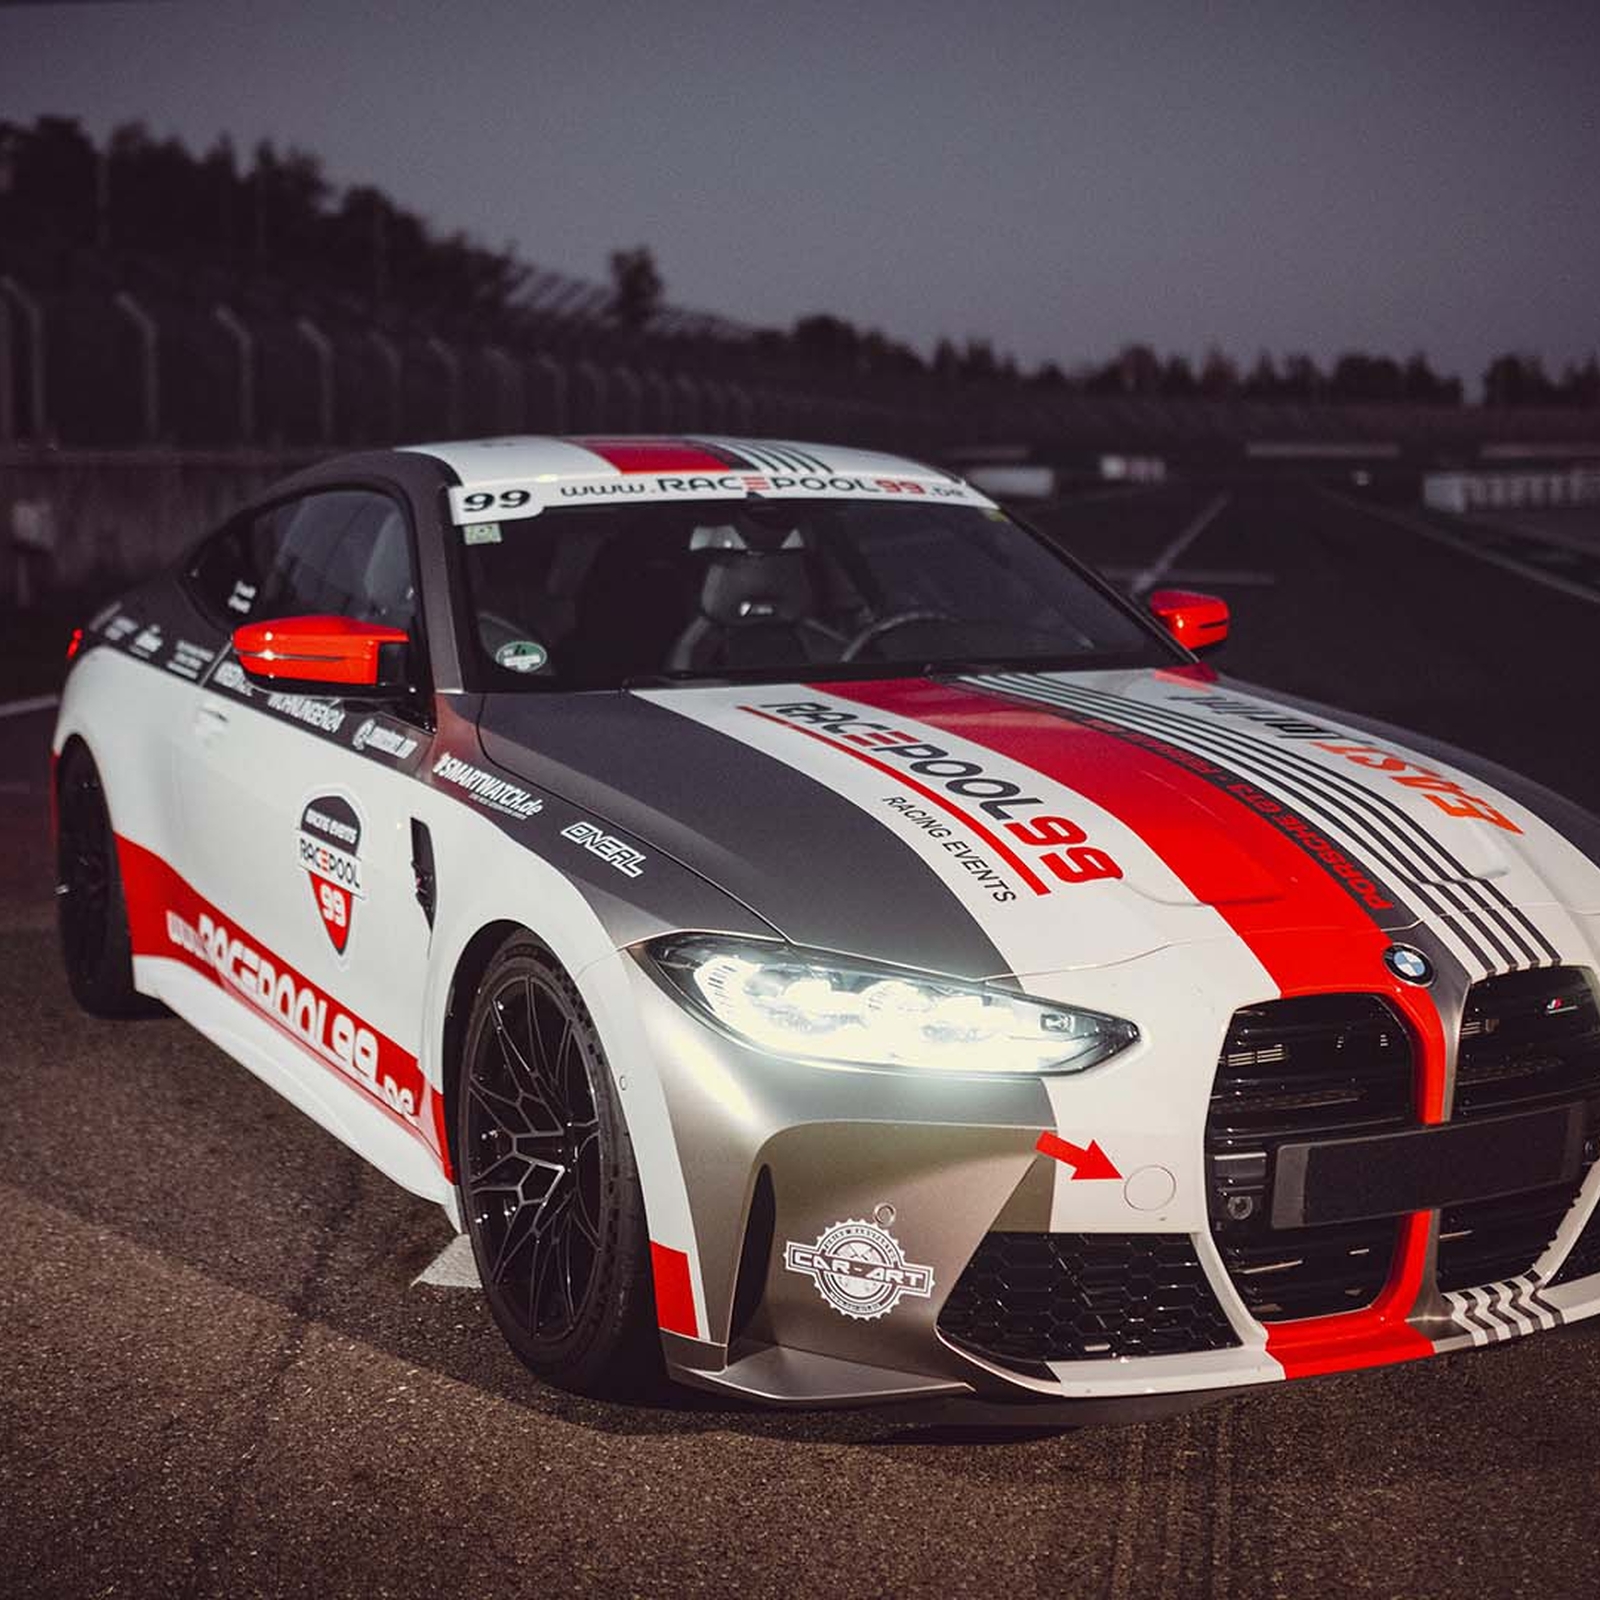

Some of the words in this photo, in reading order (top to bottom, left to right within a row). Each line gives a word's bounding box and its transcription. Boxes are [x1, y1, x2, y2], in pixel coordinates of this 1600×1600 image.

[463, 489, 531, 512] 99
[759, 702, 1124, 884] RACEPOOL99
[300, 838, 360, 888] RACEPOOL
[882, 795, 954, 840] RACING
[943, 840, 1018, 903] EVENTS
[1272, 813, 1395, 910] PORSCHE
[320, 883, 347, 927] 99
